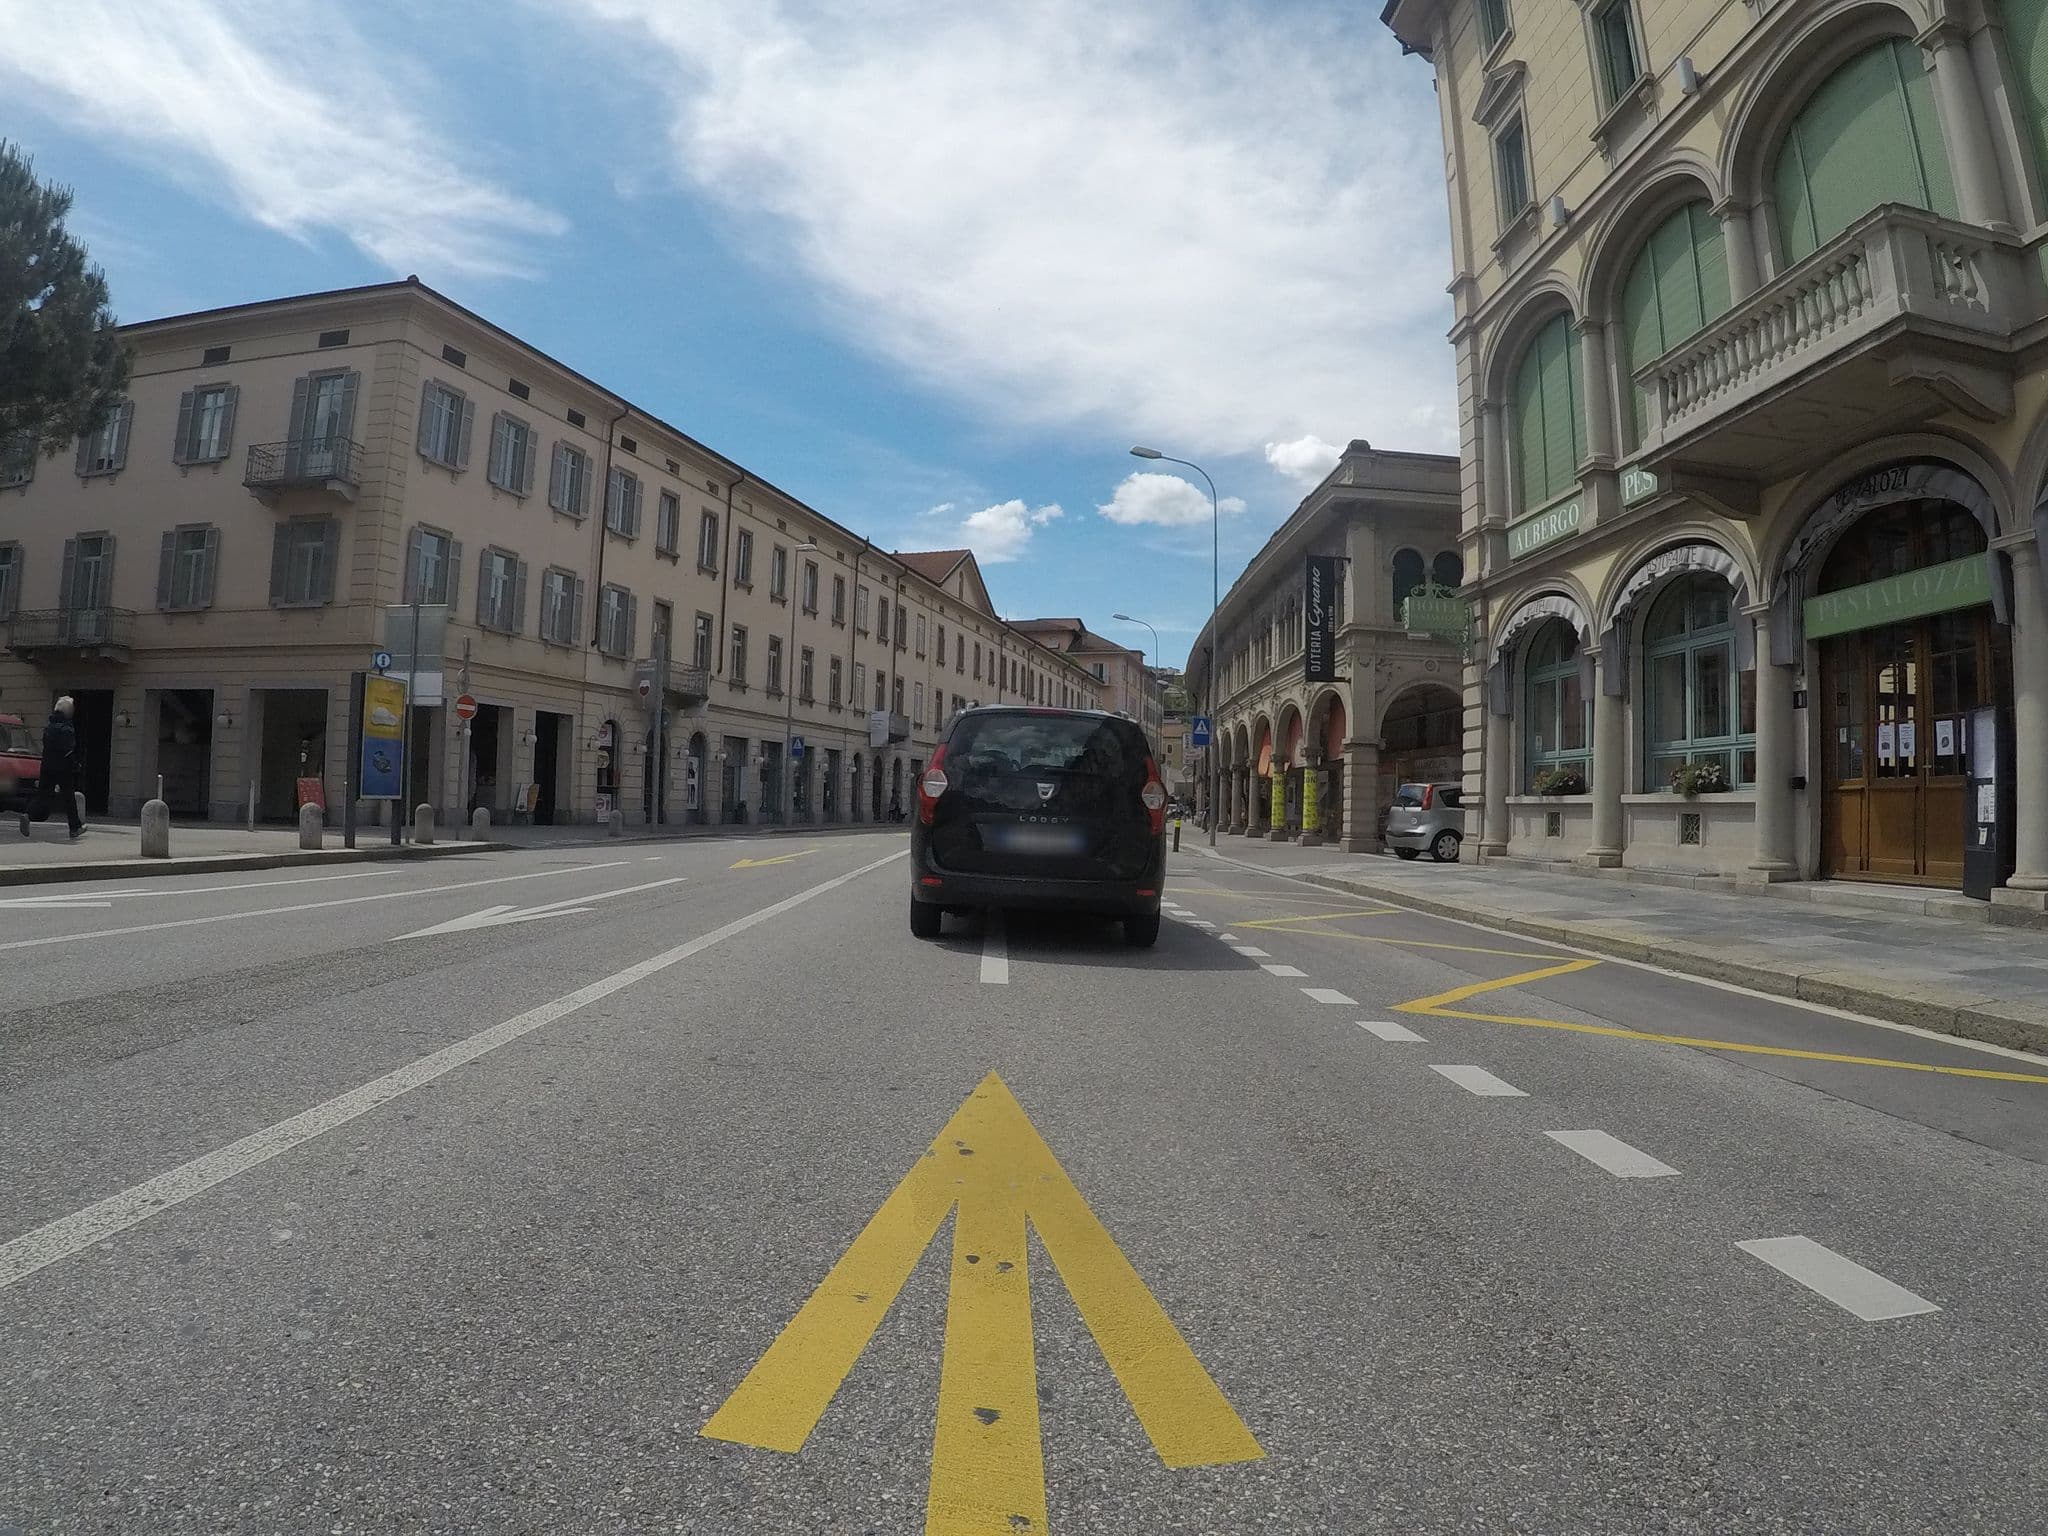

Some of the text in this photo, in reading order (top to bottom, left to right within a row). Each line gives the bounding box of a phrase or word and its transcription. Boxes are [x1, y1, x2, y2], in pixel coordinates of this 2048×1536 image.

[1515, 470, 1654, 553] ALBERGO PES
[1307, 565, 1325, 672] OSTERIA Cyrano
[1019, 815, 1070, 824] LODGY
